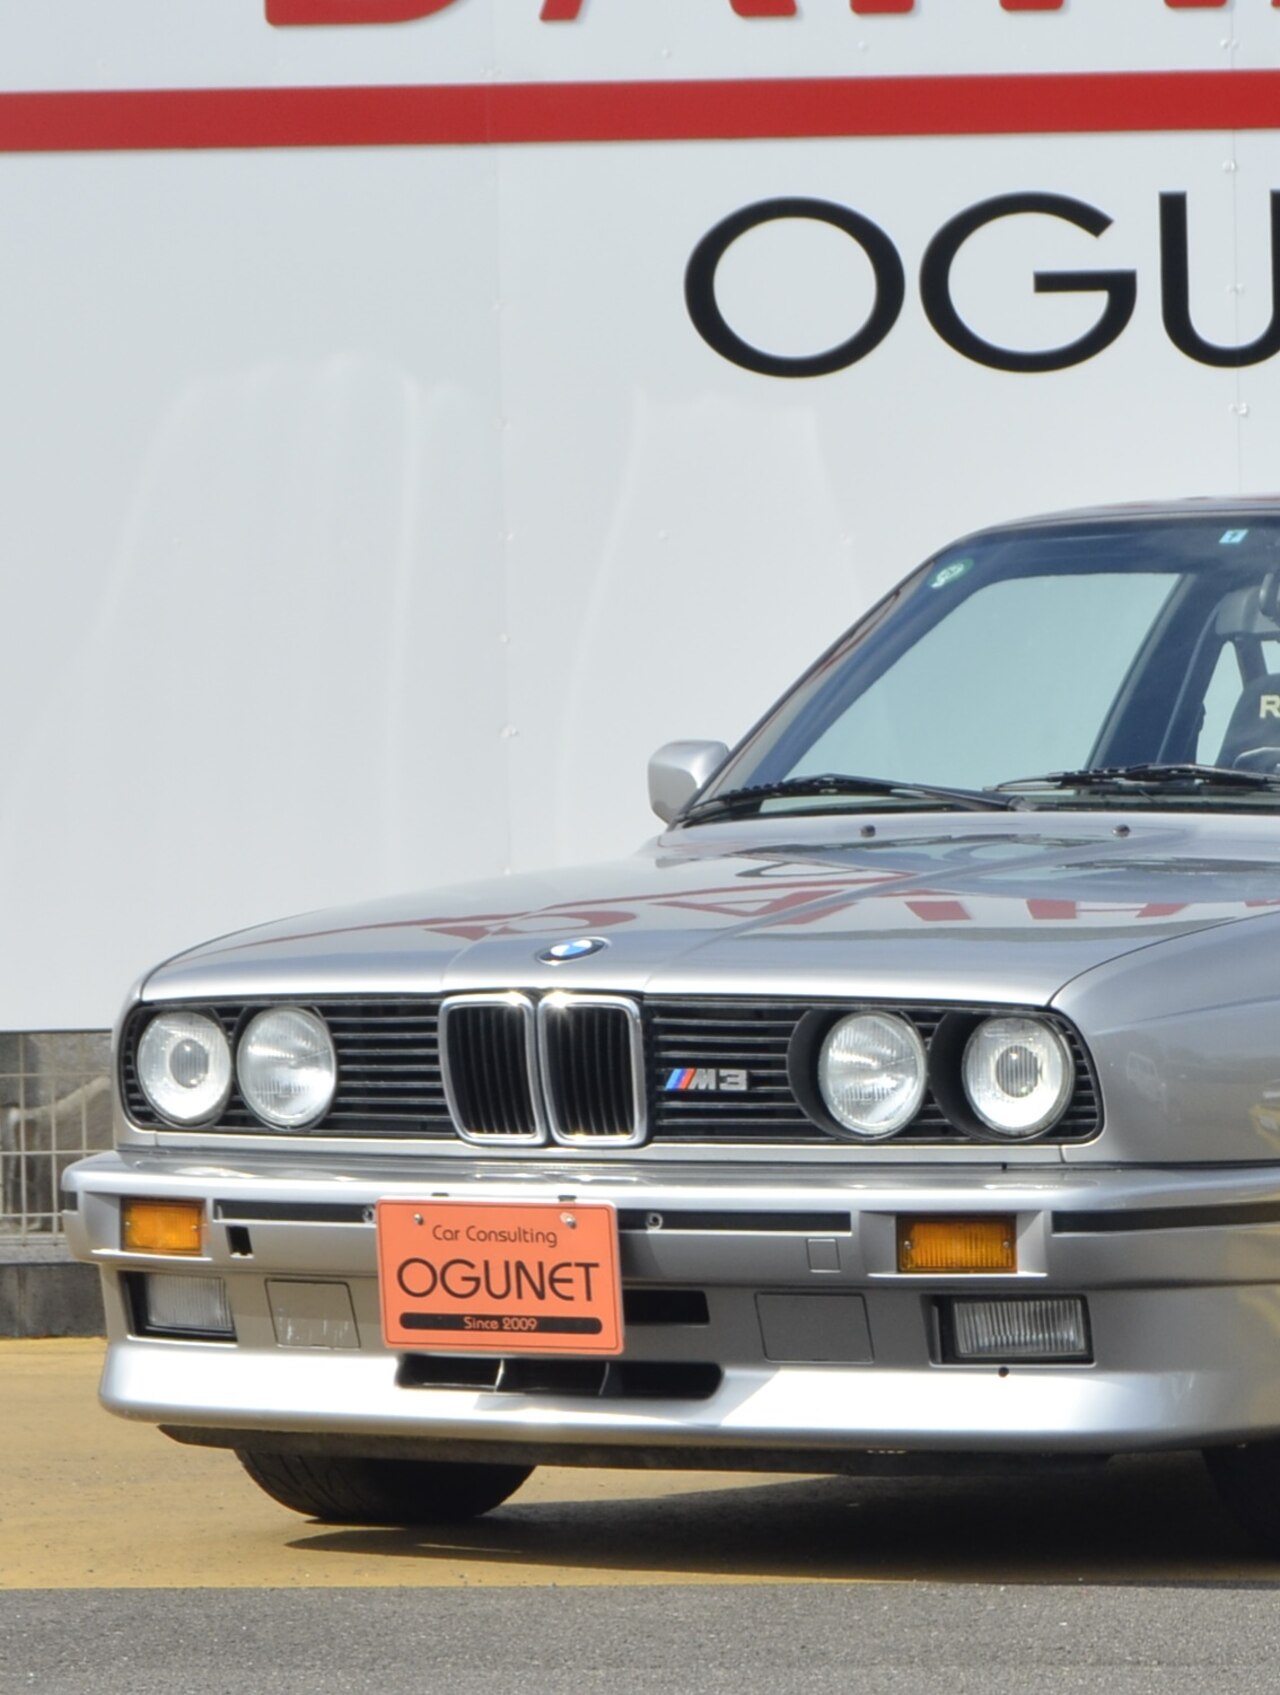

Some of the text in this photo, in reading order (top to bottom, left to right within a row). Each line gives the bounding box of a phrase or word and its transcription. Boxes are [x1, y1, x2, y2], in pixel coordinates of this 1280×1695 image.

[687, 1068, 747, 1091] M3
[432, 1225, 557, 1248] Car Consulting
[397, 1257, 600, 1302] OGUNET
[463, 1316, 538, 1331] Since 2009
